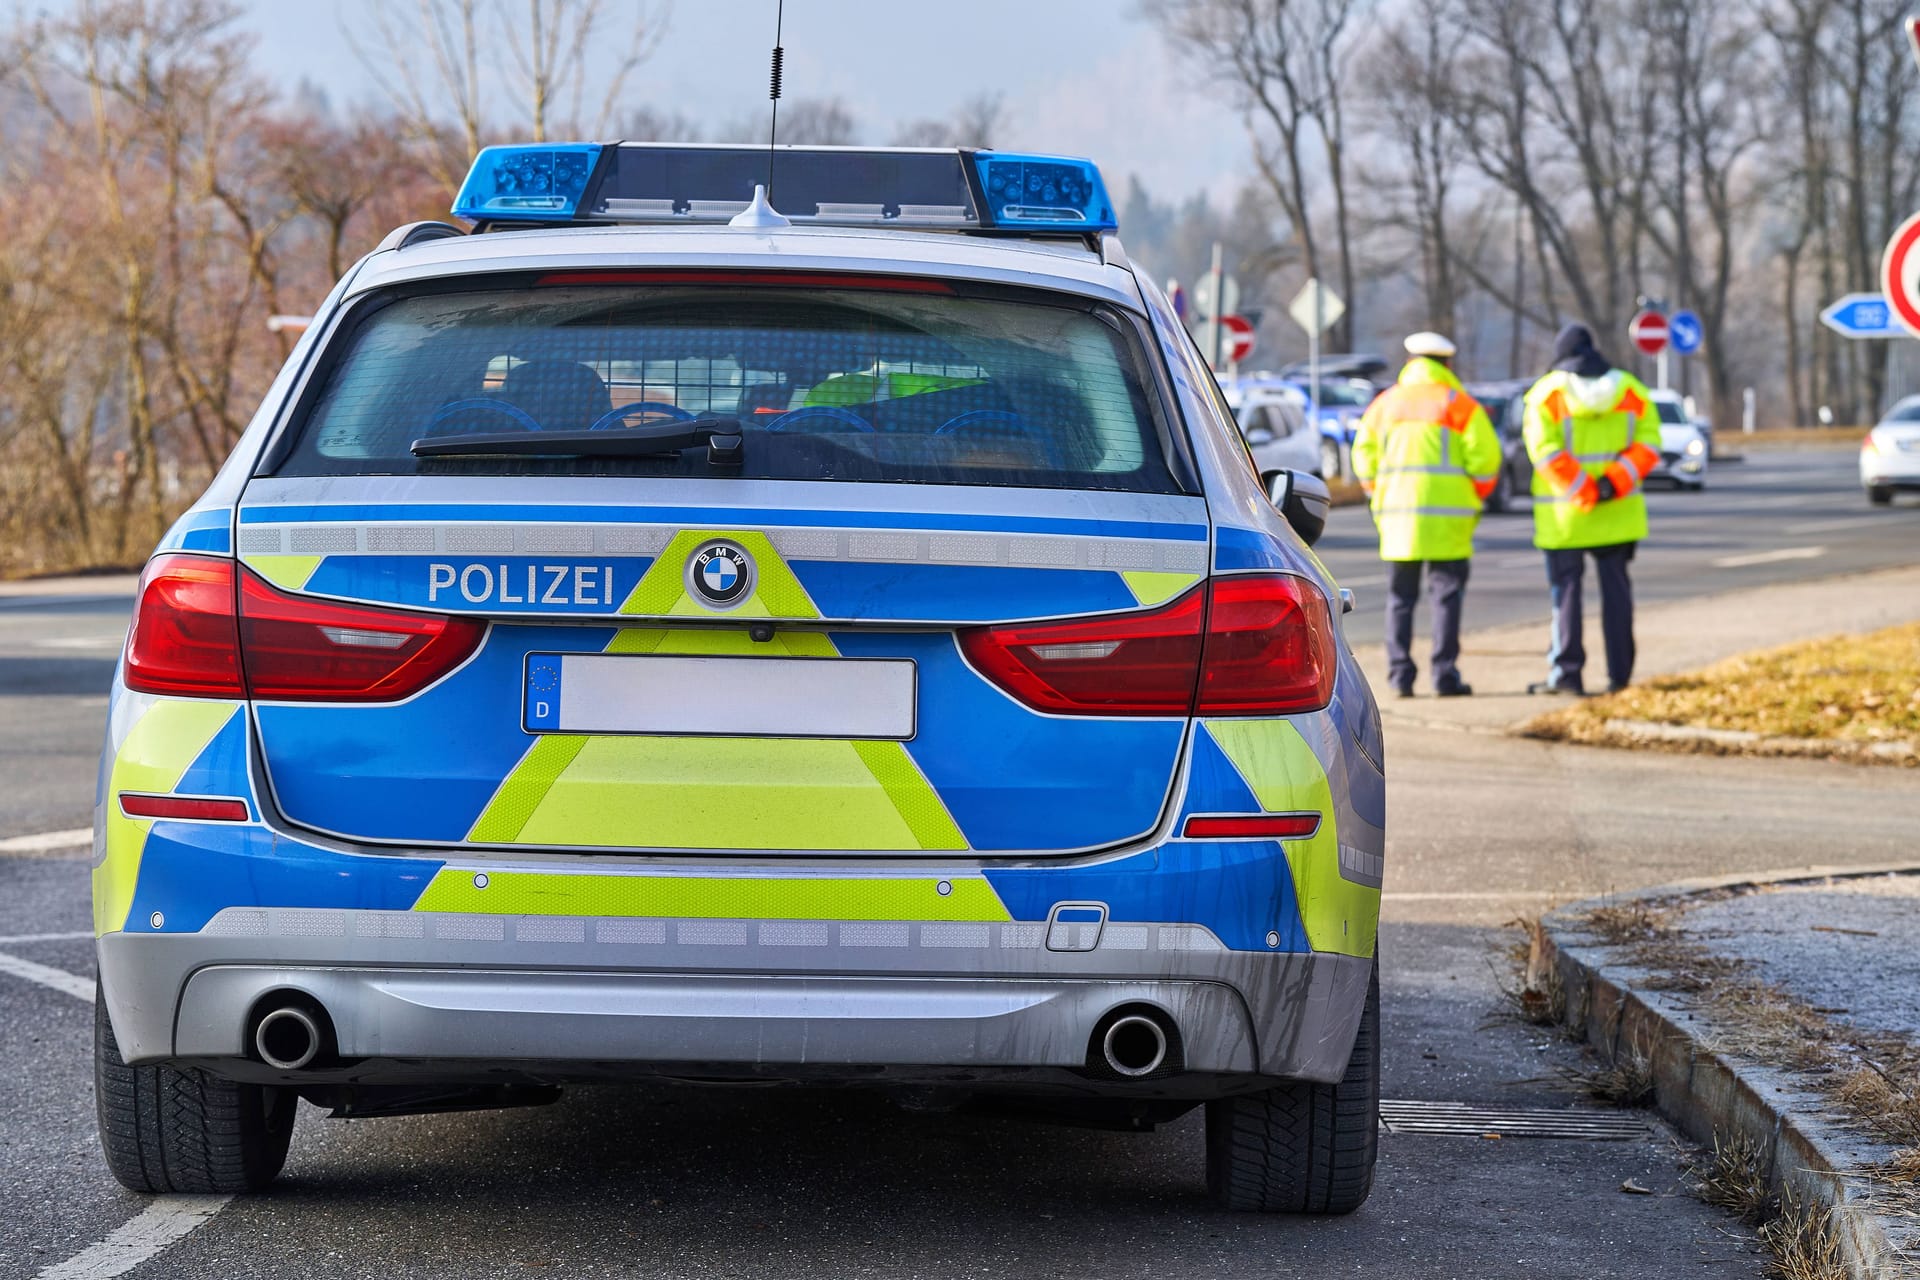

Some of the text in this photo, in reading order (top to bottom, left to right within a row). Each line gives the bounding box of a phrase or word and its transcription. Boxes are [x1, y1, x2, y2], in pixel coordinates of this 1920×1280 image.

[698, 547, 745, 566] BMW
[429, 563, 613, 605] POLIZEI
[535, 701, 549, 718] D
